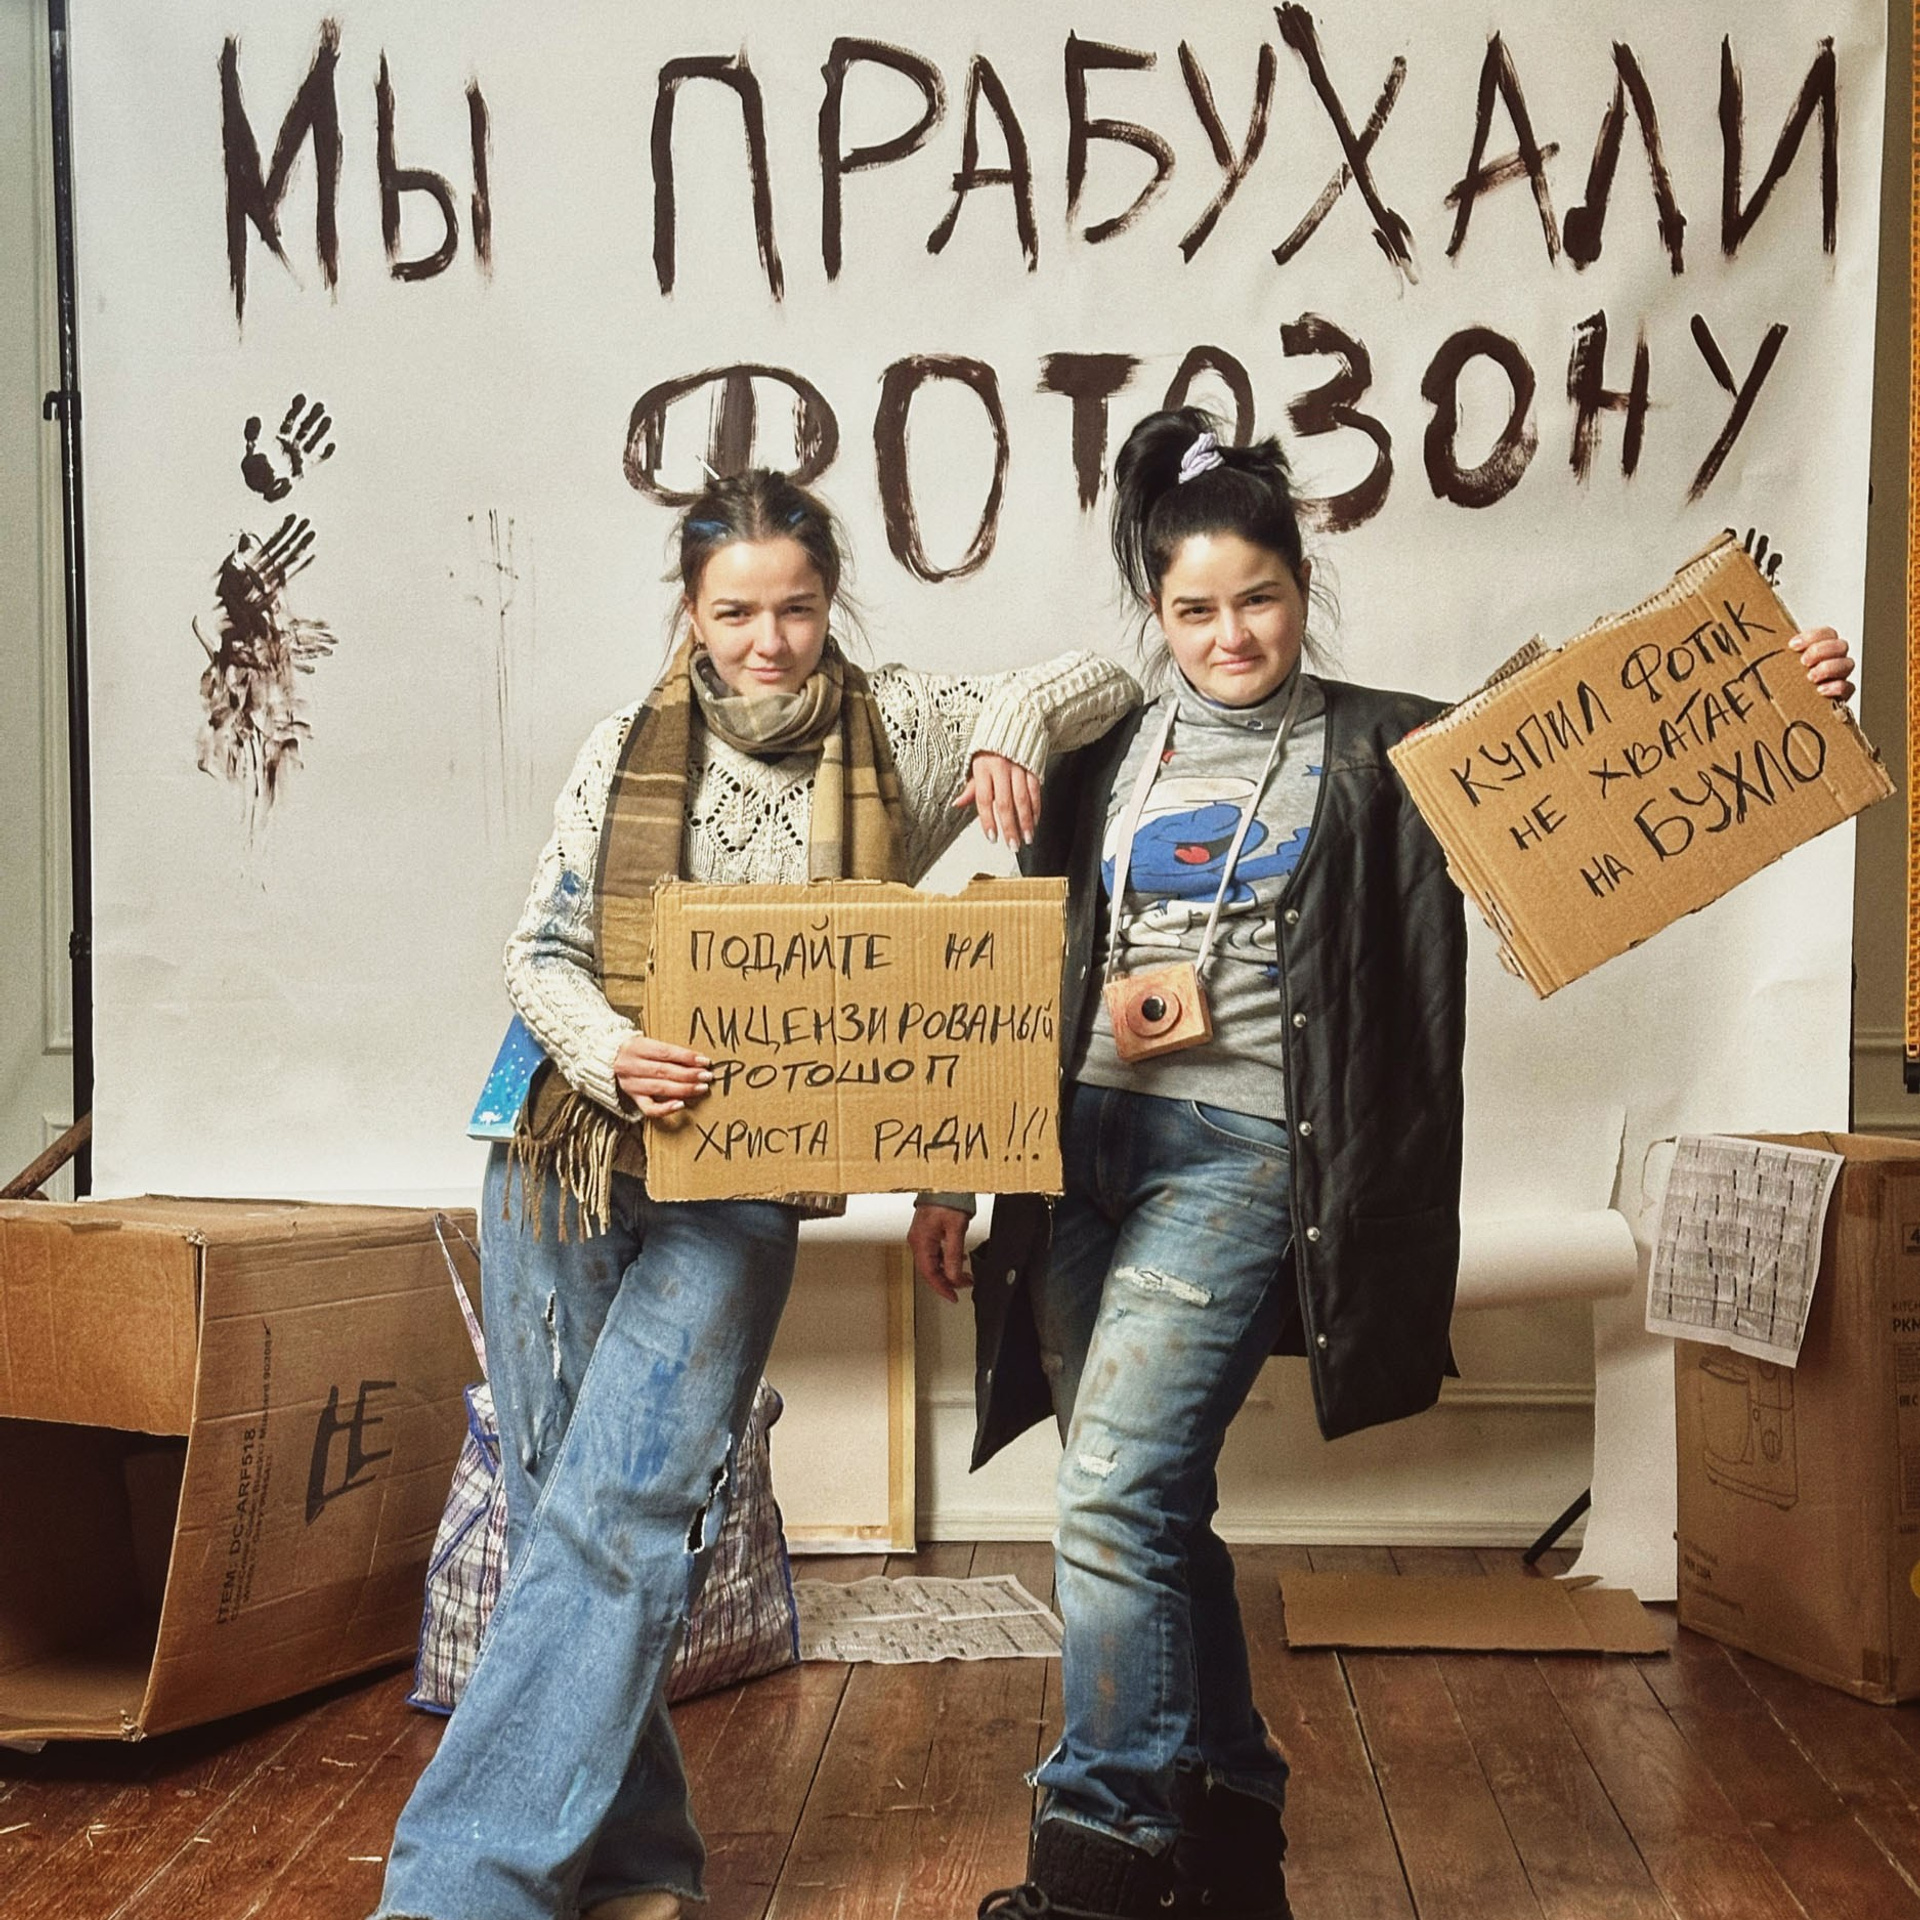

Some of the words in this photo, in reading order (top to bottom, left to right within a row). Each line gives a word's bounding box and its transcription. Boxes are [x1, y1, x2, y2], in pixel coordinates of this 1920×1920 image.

[217, 17, 494, 340] МЫ
[652, 2, 1838, 305] ПРАБУХАЛИ
[1450, 681, 1612, 806] КУПИЛ
[1621, 601, 1776, 703] ФОТИК
[1510, 795, 1566, 851] НЕ
[1589, 649, 1785, 798] ХВАТАЕТ
[1579, 853, 1634, 898] НА
[1633, 720, 1826, 861] БУХЛО
[690, 915, 892, 983] ПОДАЙТЕ
[944, 930, 995, 972] НА
[694, 1120, 829, 1162] ХРИСТА
